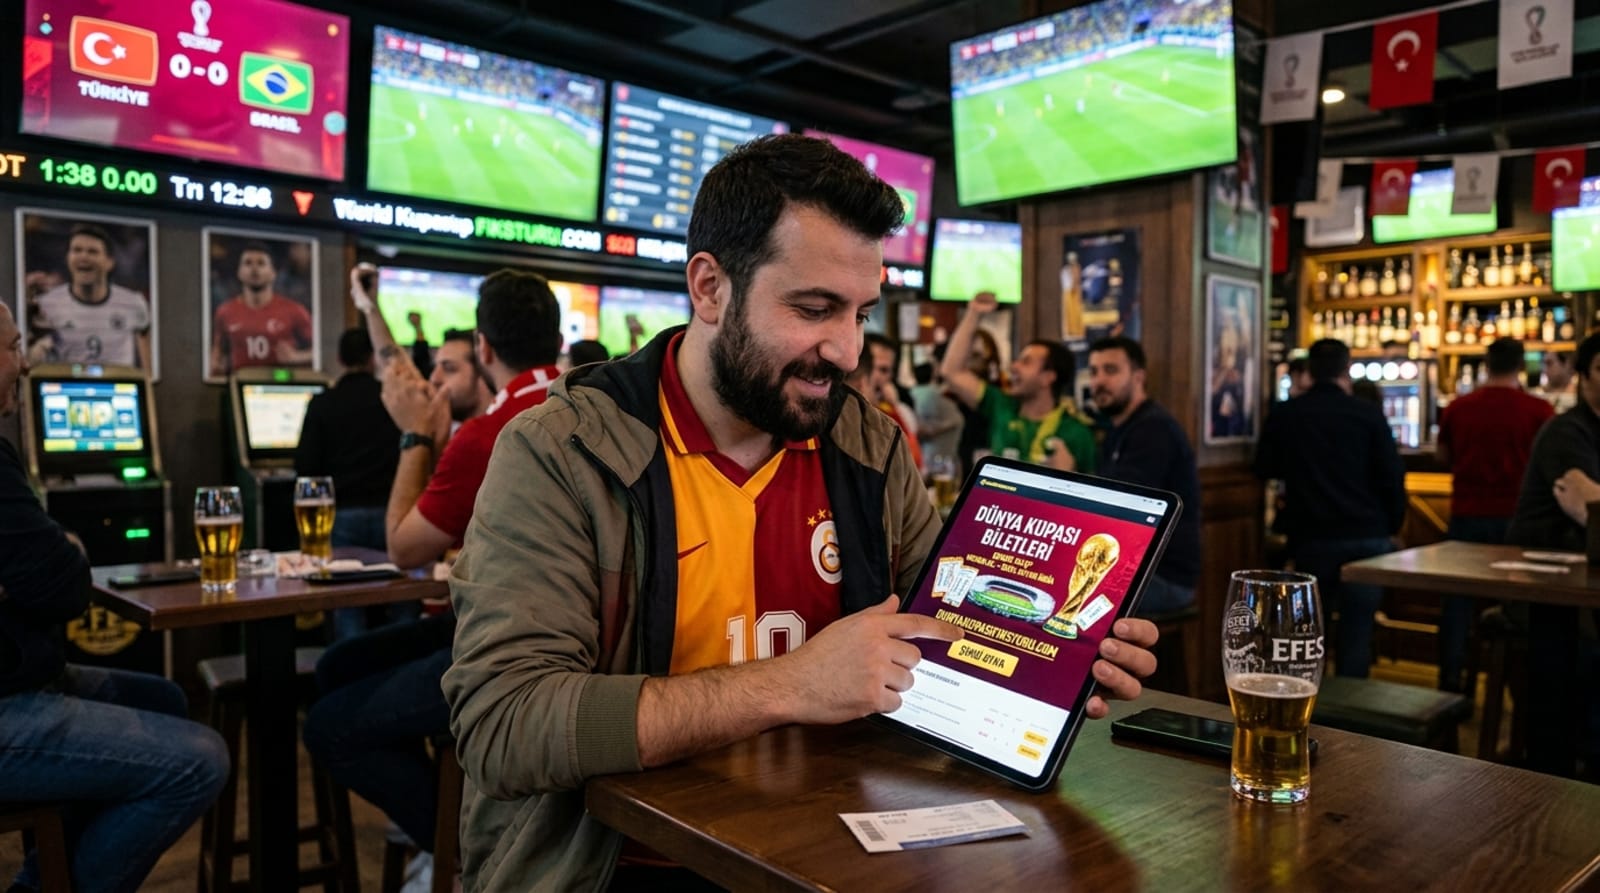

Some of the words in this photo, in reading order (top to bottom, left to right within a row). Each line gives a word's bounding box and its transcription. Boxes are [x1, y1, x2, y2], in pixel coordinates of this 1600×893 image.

[40, 158, 97, 187] 1:38
[102, 166, 157, 194] 0.00
[86, 335, 101, 358] 9
[246, 337, 269, 359] 10
[974, 504, 1024, 532] DÜNYA
[1022, 516, 1082, 546] KUPASI
[980, 527, 1056, 561] BİLETLERİ
[726, 609, 807, 666] 10
[1271, 636, 1324, 661] EFES
